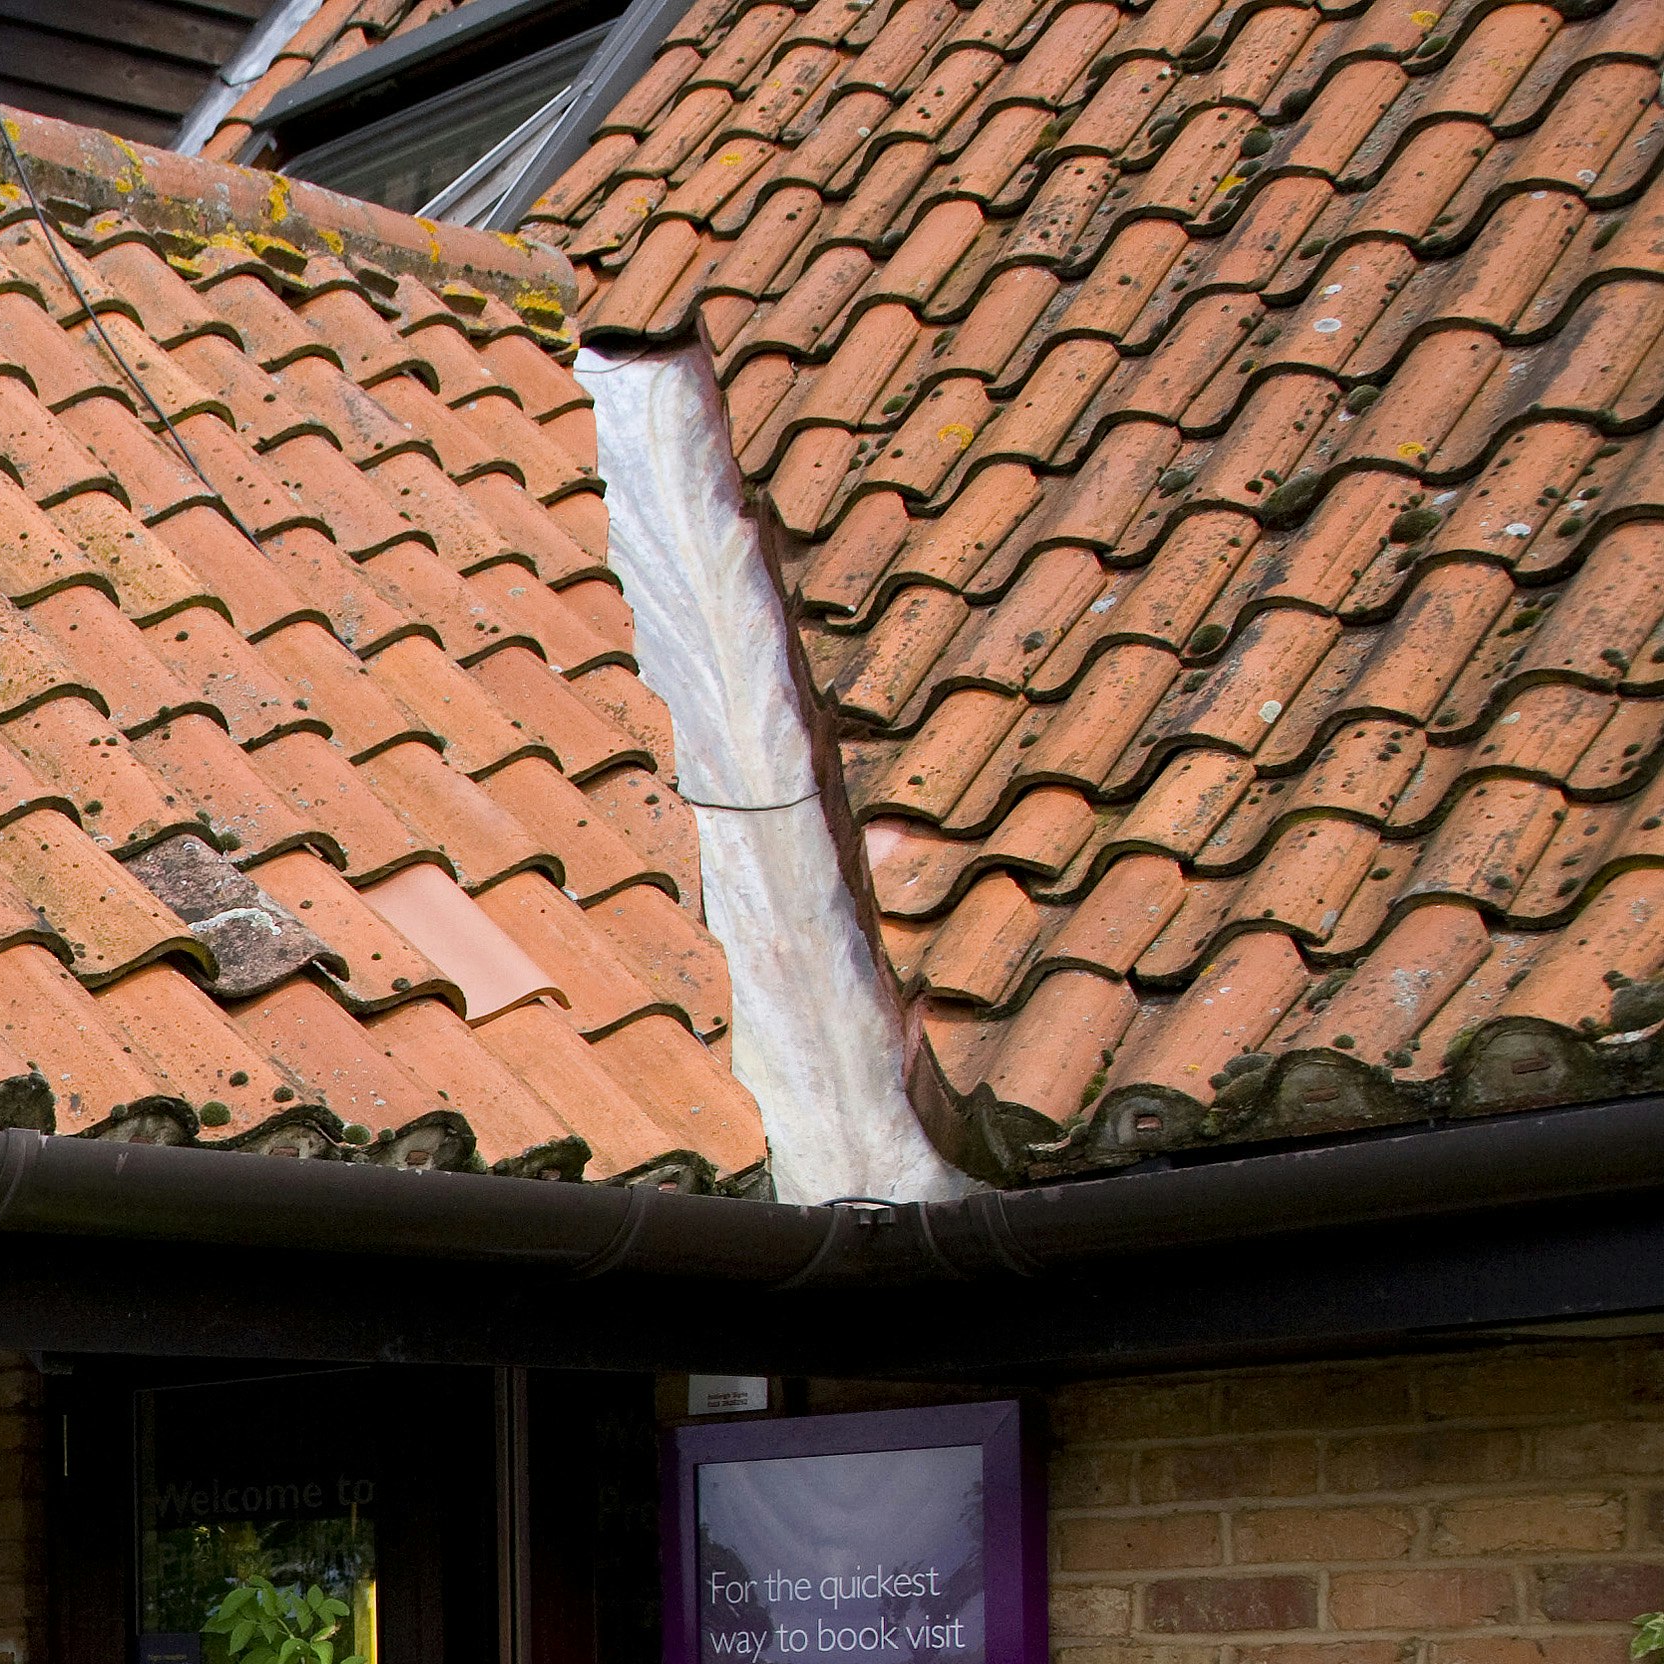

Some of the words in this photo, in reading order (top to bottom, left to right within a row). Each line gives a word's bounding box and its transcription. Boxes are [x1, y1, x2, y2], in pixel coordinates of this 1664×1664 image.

[156, 1477, 324, 1518] Welcome
[336, 1472, 376, 1506] to
[710, 1571, 758, 1604] For
[764, 1568, 812, 1602] the
[819, 1564, 942, 1610] quickest
[709, 1630, 768, 1664] way
[775, 1623, 808, 1653] to
[817, 1616, 900, 1652] book
[905, 1613, 966, 1650] visit
